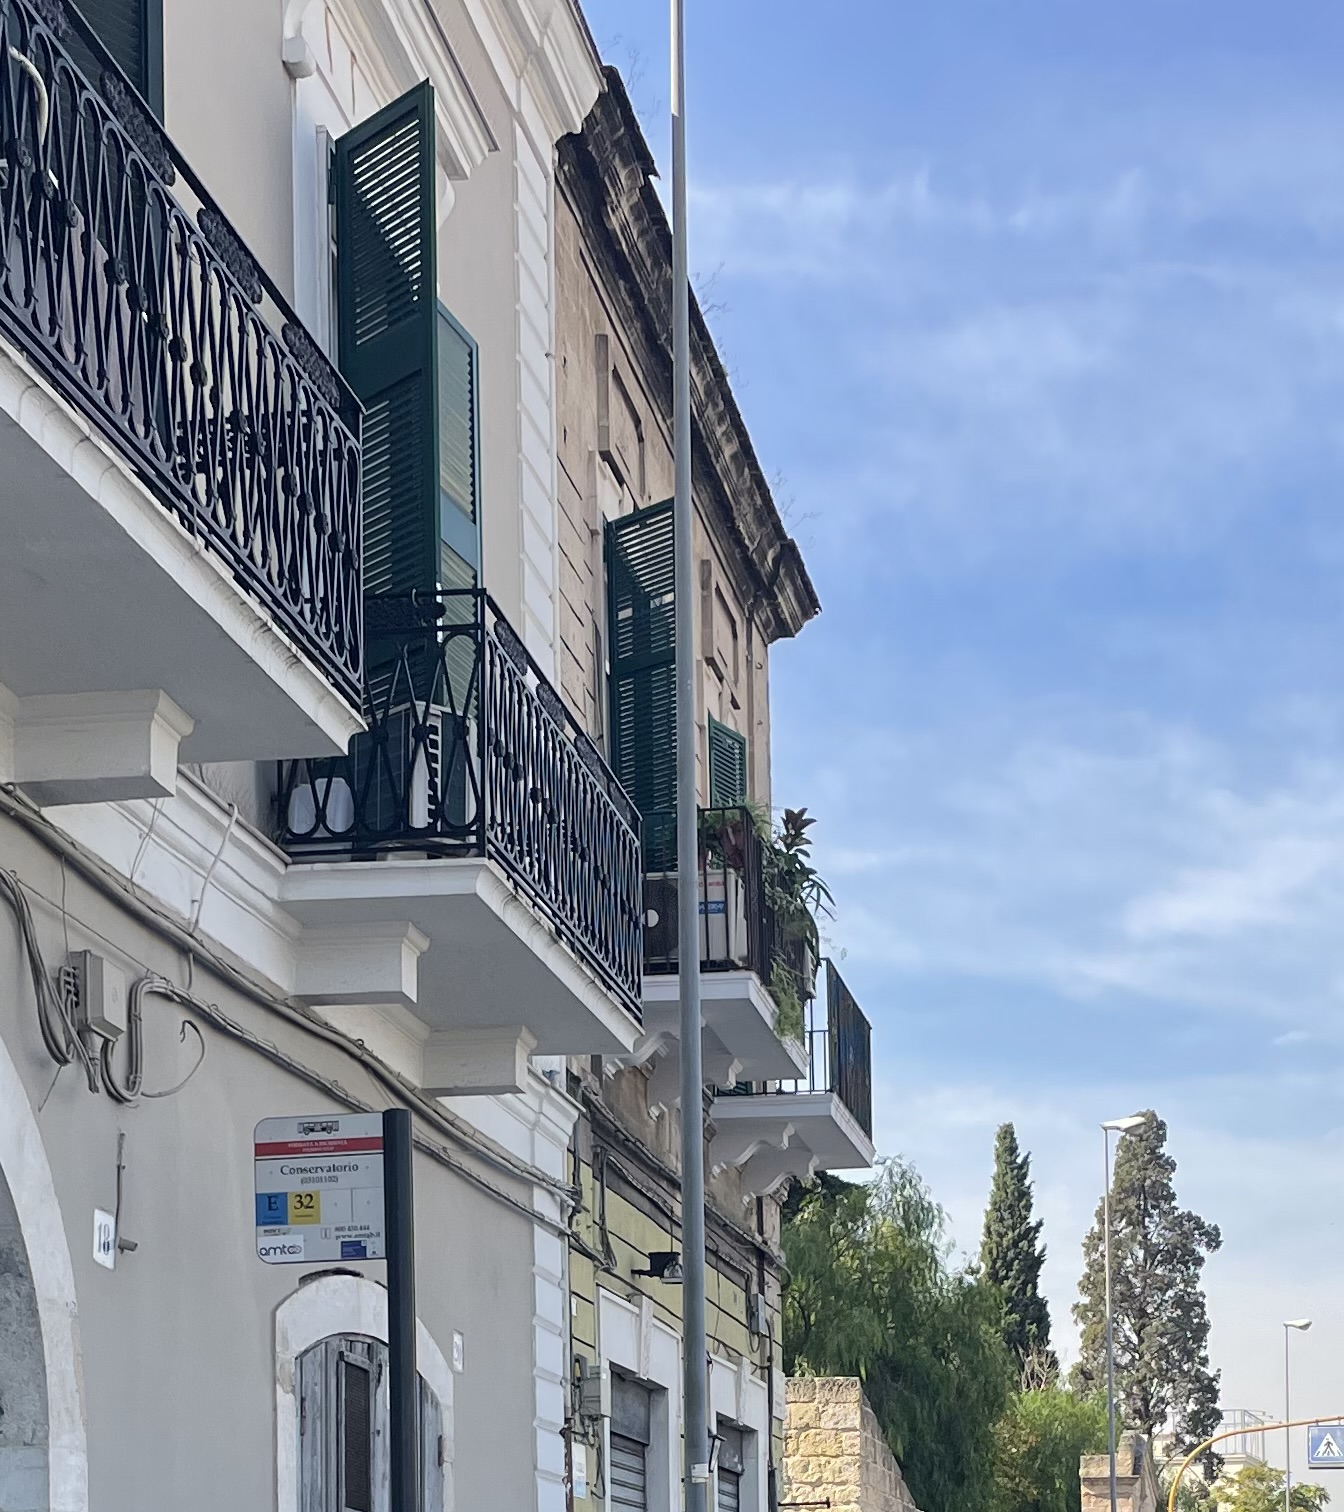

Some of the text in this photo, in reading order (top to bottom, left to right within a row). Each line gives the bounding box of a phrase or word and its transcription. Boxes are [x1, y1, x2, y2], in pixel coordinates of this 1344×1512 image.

[280, 1162, 359, 1175] Conservatorio
[267, 1195, 278, 1211] E
[293, 1193, 315, 1210] 32
[97, 1222, 111, 1256] 18
